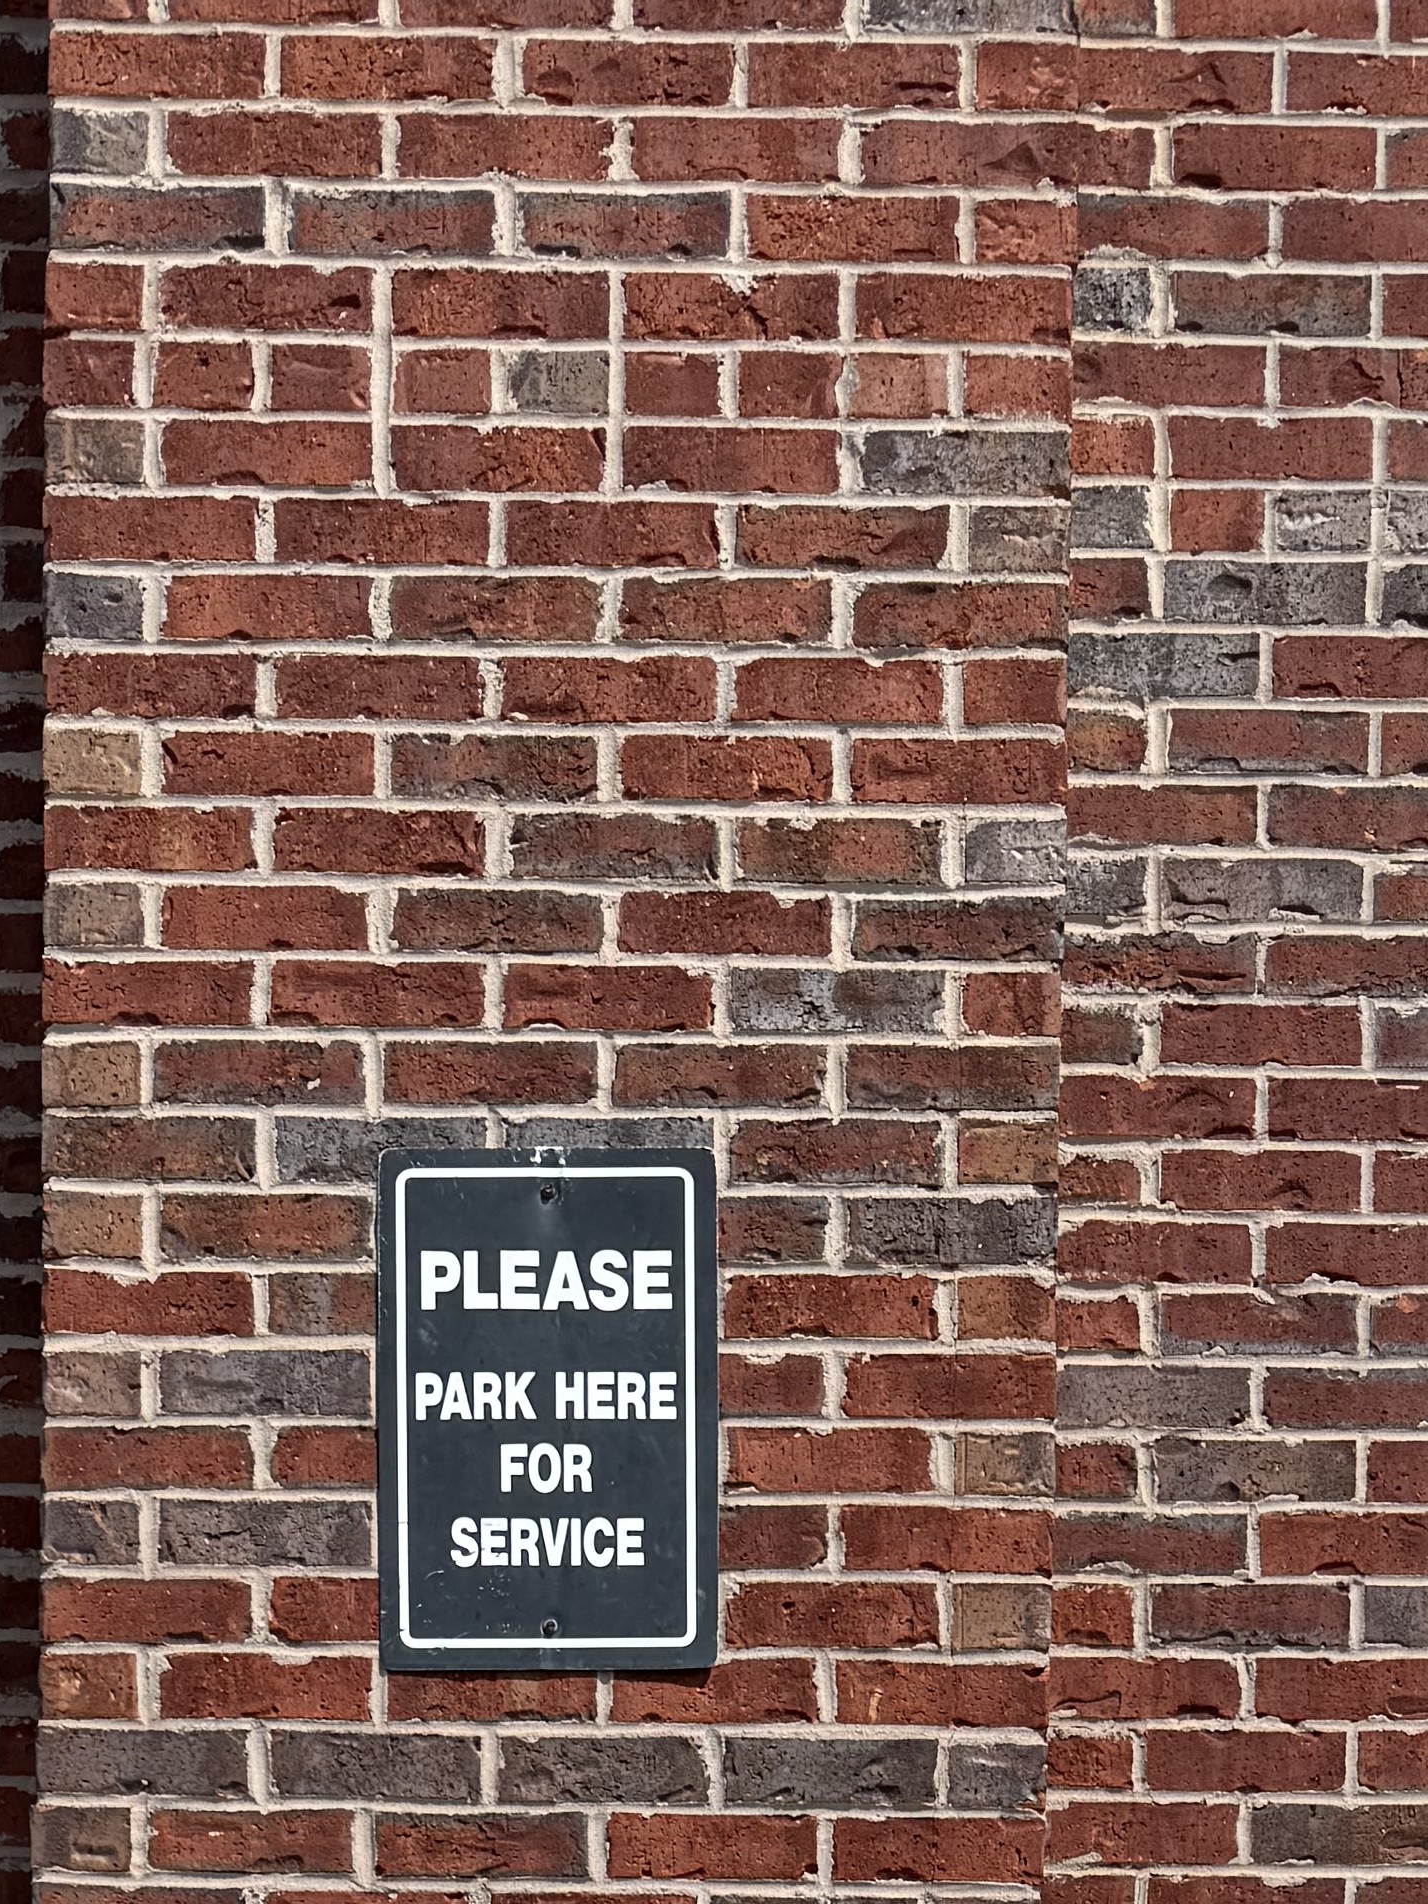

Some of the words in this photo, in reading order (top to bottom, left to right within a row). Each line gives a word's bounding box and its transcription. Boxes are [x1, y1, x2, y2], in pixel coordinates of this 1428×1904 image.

[419, 1249, 673, 1312] PLEASE
[414, 1371, 537, 1421] PARK
[555, 1371, 678, 1420] HERE
[500, 1442, 593, 1494] FOR
[449, 1516, 645, 1568] SERVICE
